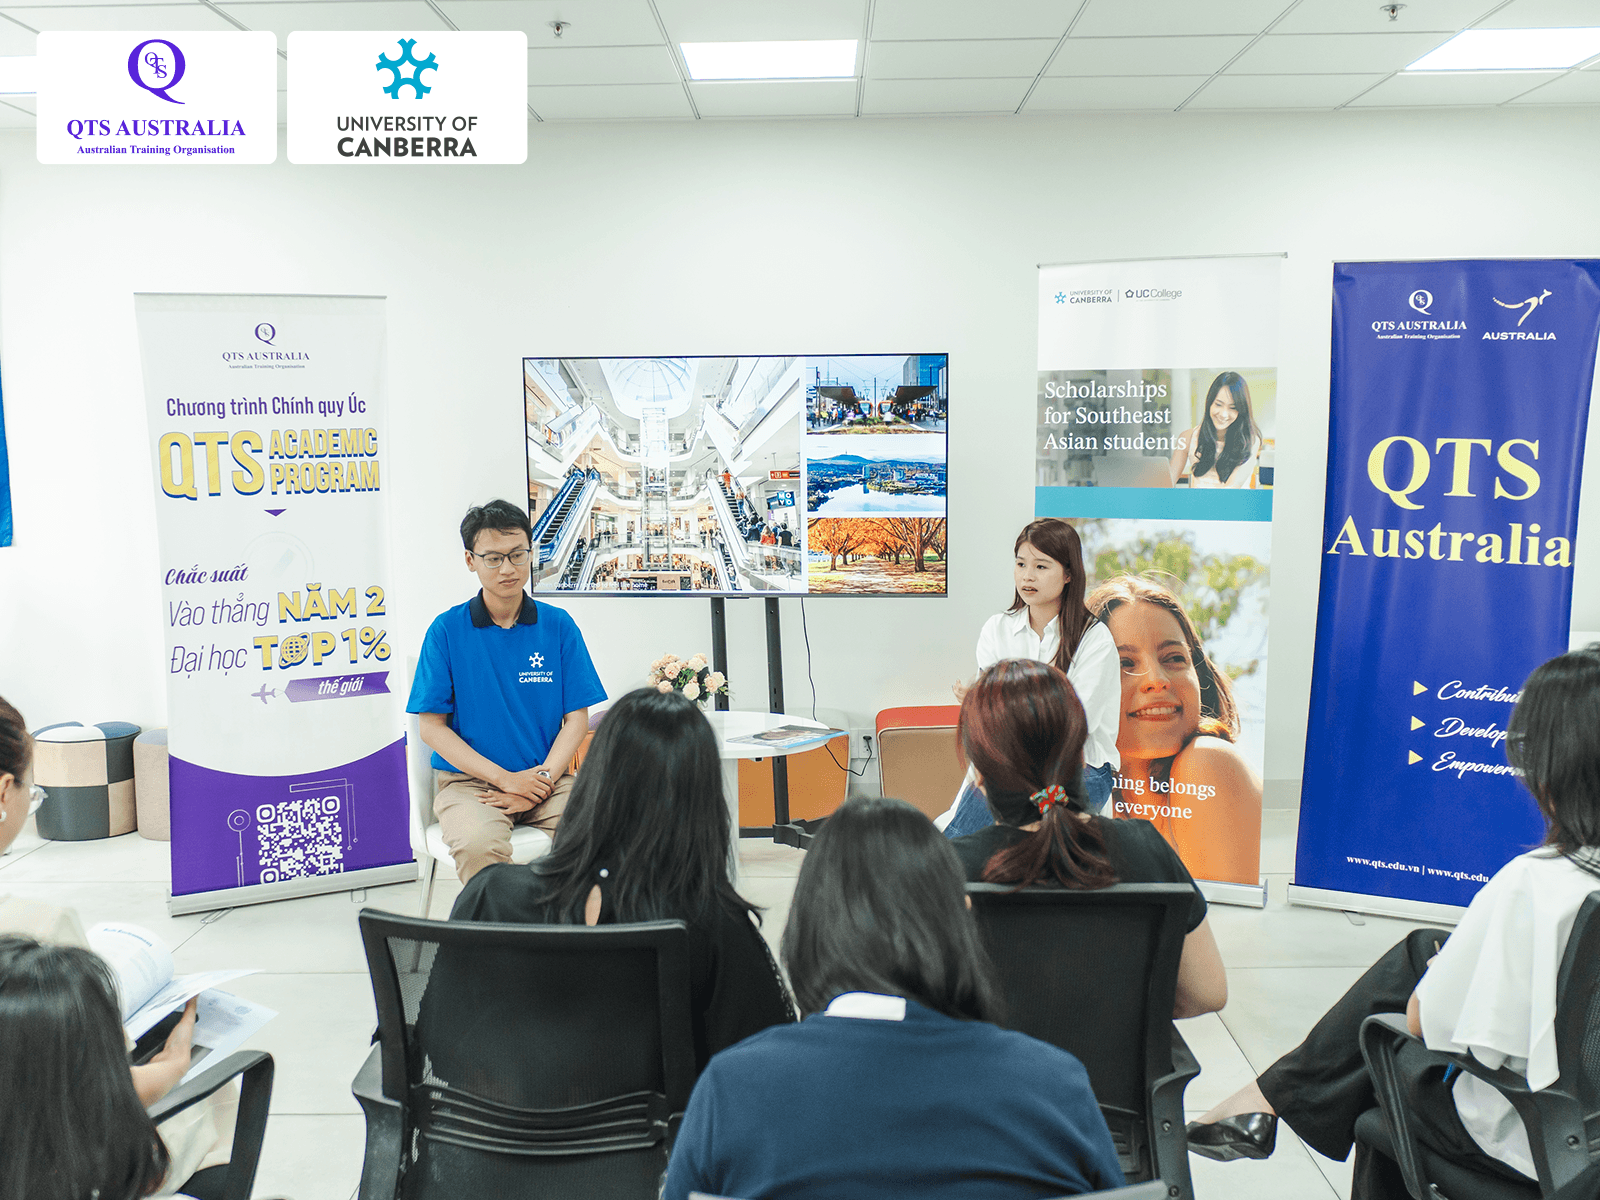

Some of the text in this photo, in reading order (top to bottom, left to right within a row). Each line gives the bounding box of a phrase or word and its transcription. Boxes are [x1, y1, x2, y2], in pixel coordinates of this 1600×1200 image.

[1069, 295, 1113, 304] CANBERRA
[1371, 320, 1468, 333] QTS AUSTRALIA
[1482, 331, 1557, 341] AUSTRALIA
[222, 351, 310, 363] QTS AUSTRALIA
[1044, 379, 1167, 403] Scholarships
[166, 391, 366, 419] Chương trình Chính quy Úc
[1044, 406, 1172, 425] for Southeast
[1043, 432, 1187, 451] Asian students
[158, 427, 379, 501] QTS ACADEMIC
[1366, 435, 1542, 511] QTS
[269, 460, 381, 496] PROGRAM
[1326, 514, 1573, 568] Australia
[164, 562, 249, 586] Chắc suất
[168, 582, 386, 627] Vào thẳng NĂM 2
[170, 645, 204, 679] Đại
[208, 643, 248, 676] học
[341, 626, 392, 665] 1%
[317, 676, 365, 696] thế giới
[518, 676, 554, 684] CANBERRA
[1149, 776, 1216, 801] belongs
[1115, 801, 1193, 820] everyone
[1346, 856, 1420, 873] www.qts.edu.vn
